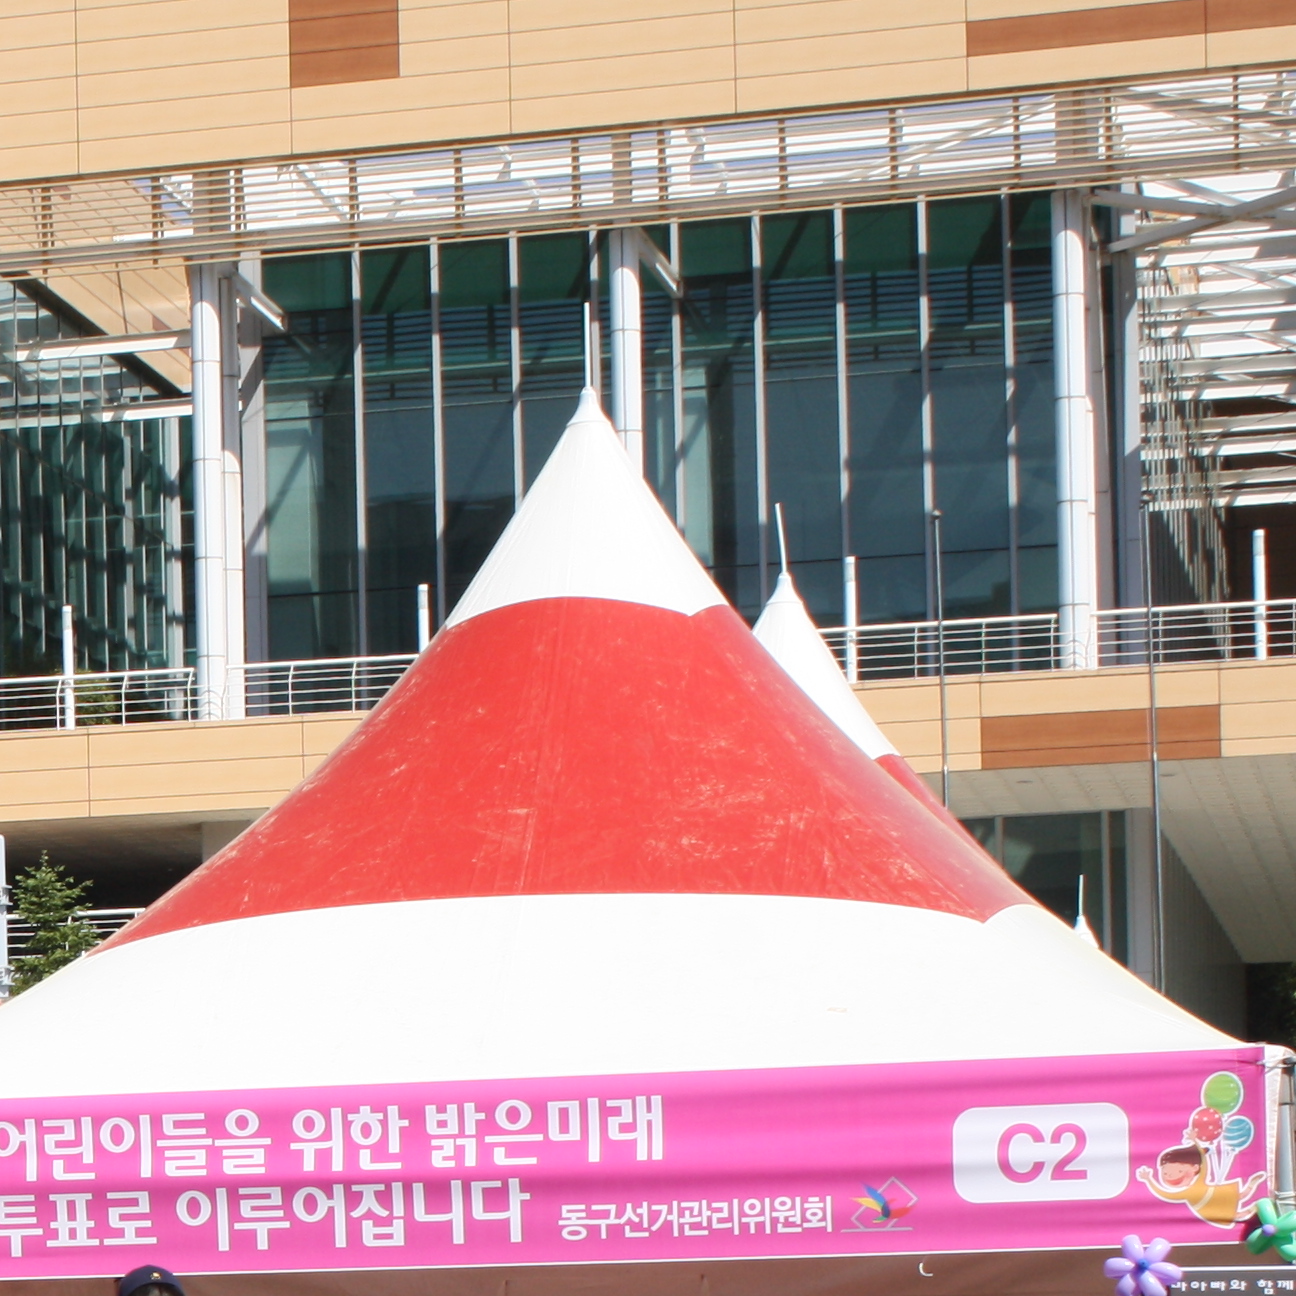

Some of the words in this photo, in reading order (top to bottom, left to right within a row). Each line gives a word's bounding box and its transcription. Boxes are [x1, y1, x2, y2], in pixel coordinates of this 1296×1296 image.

[290, 1104, 410, 1173] 위한
[425, 1095, 665, 1170] 밝은미래
[995, 1122, 1089, 1183] C2
[175, 1178, 531, 1252] 이루어집니다
[559, 1193, 834, 1241] 동구선거관리위원회
[1257, 1279, 1294, 1295] 함께
